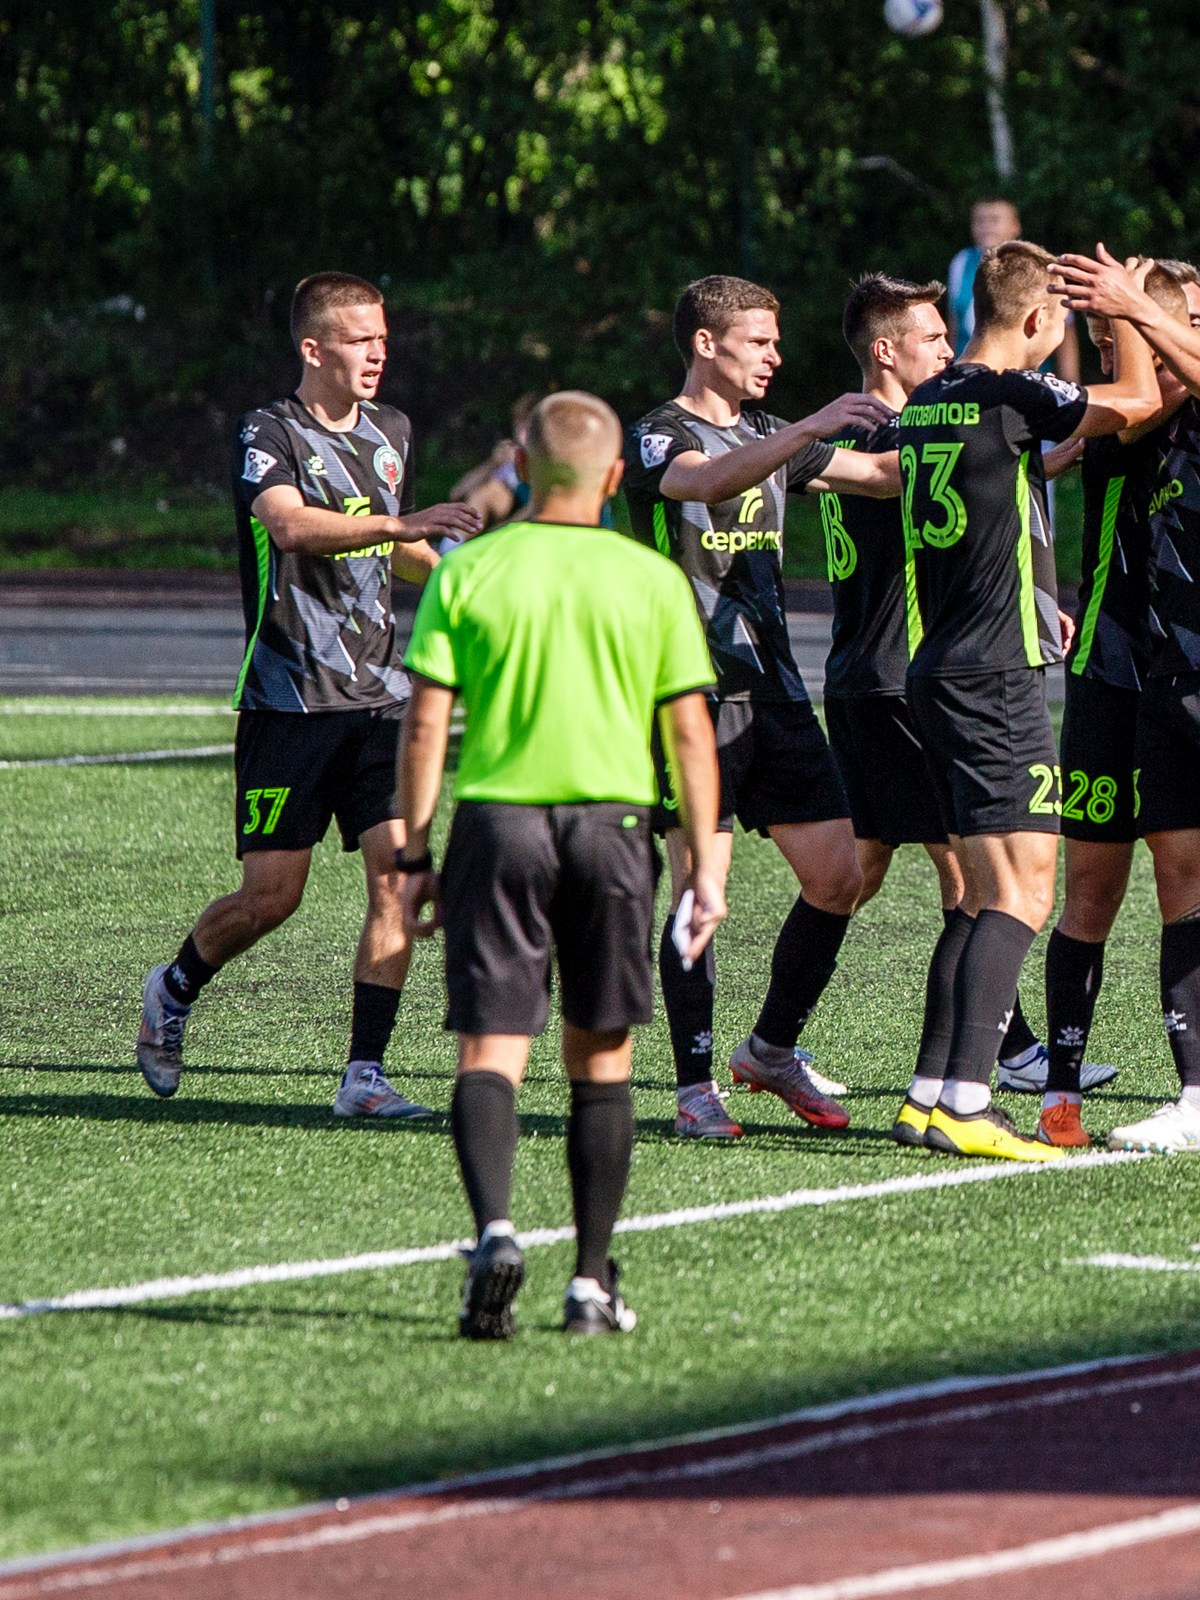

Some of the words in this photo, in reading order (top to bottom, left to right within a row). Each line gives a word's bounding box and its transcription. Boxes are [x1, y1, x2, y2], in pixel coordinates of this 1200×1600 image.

[901, 442, 967, 548] 23
[243, 786, 292, 835] 37
[1062, 769, 1118, 824] 28
